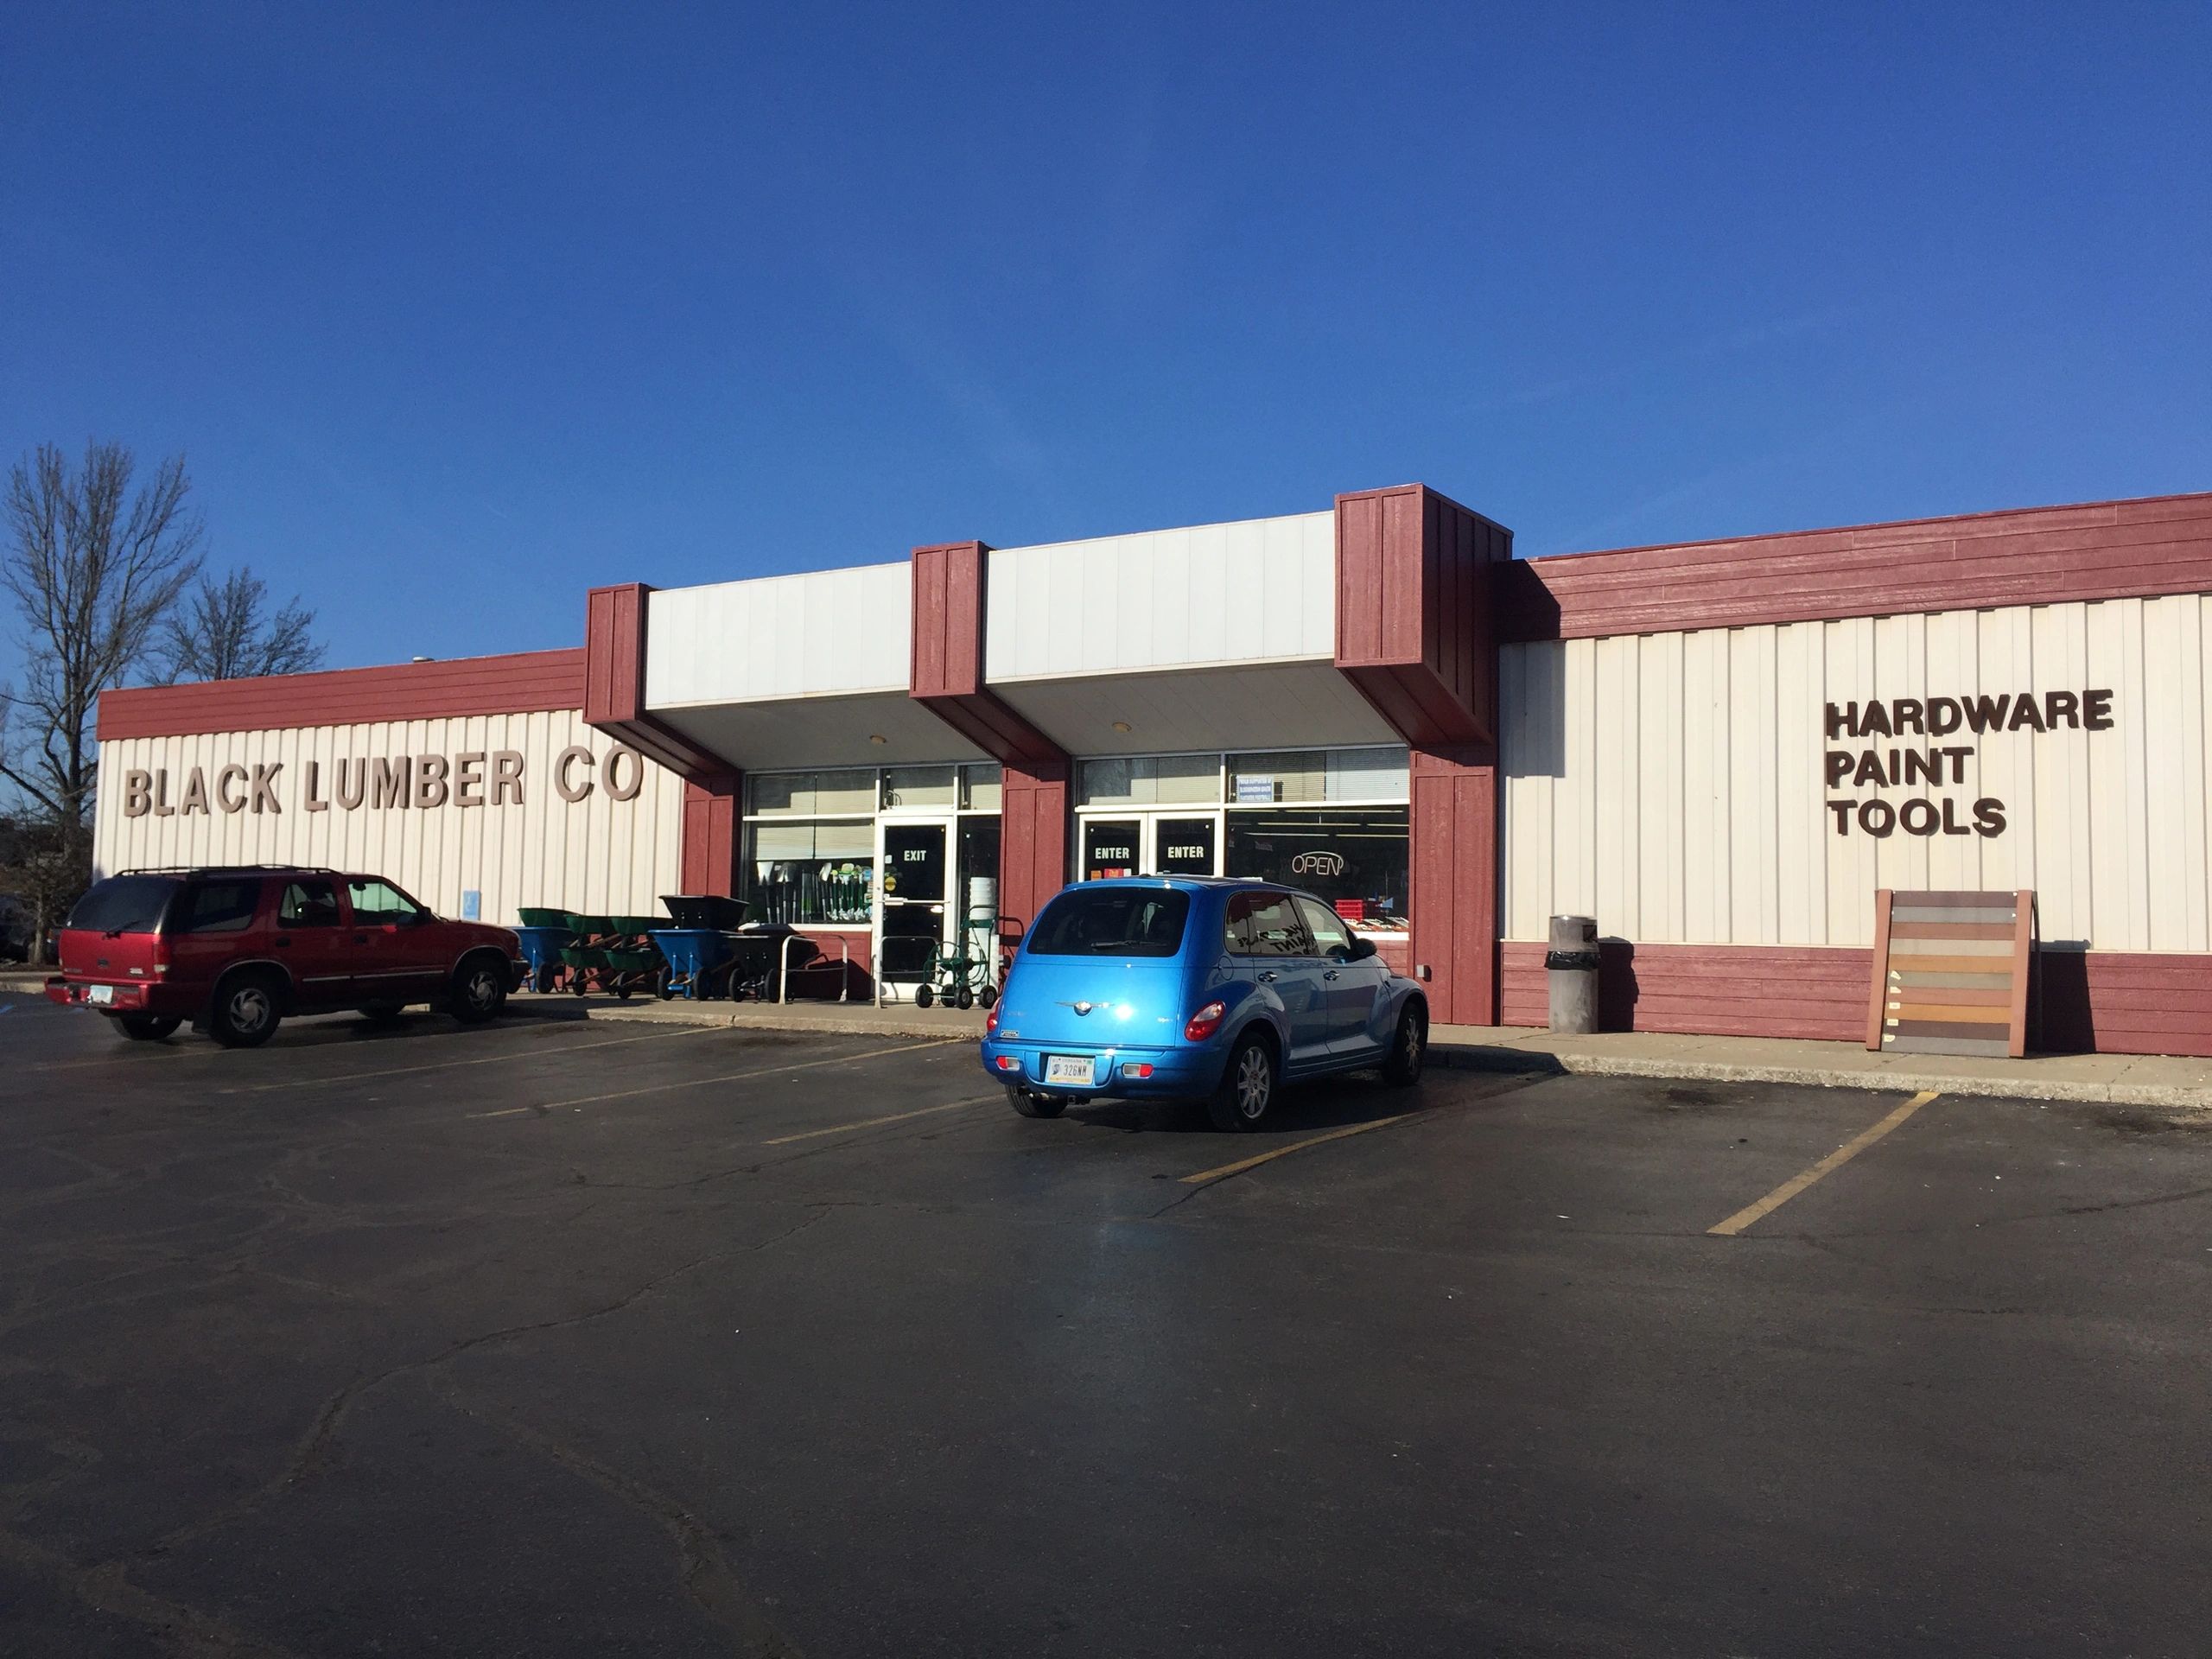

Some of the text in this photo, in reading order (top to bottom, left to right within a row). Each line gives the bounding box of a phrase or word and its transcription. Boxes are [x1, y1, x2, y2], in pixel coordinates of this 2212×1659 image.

[1826, 689, 2114, 741] HARDWARE
[124, 745, 644, 817] BLACK LUMBER CO
[1827, 747, 1974, 788] PAINT
[1827, 798, 2006, 837] TOOLS
[904, 850, 926, 861] EXIT
[1095, 847, 1129, 859] ENTER
[1167, 846, 1205, 858] ENTER
[1292, 854, 1341, 876] OPEN
